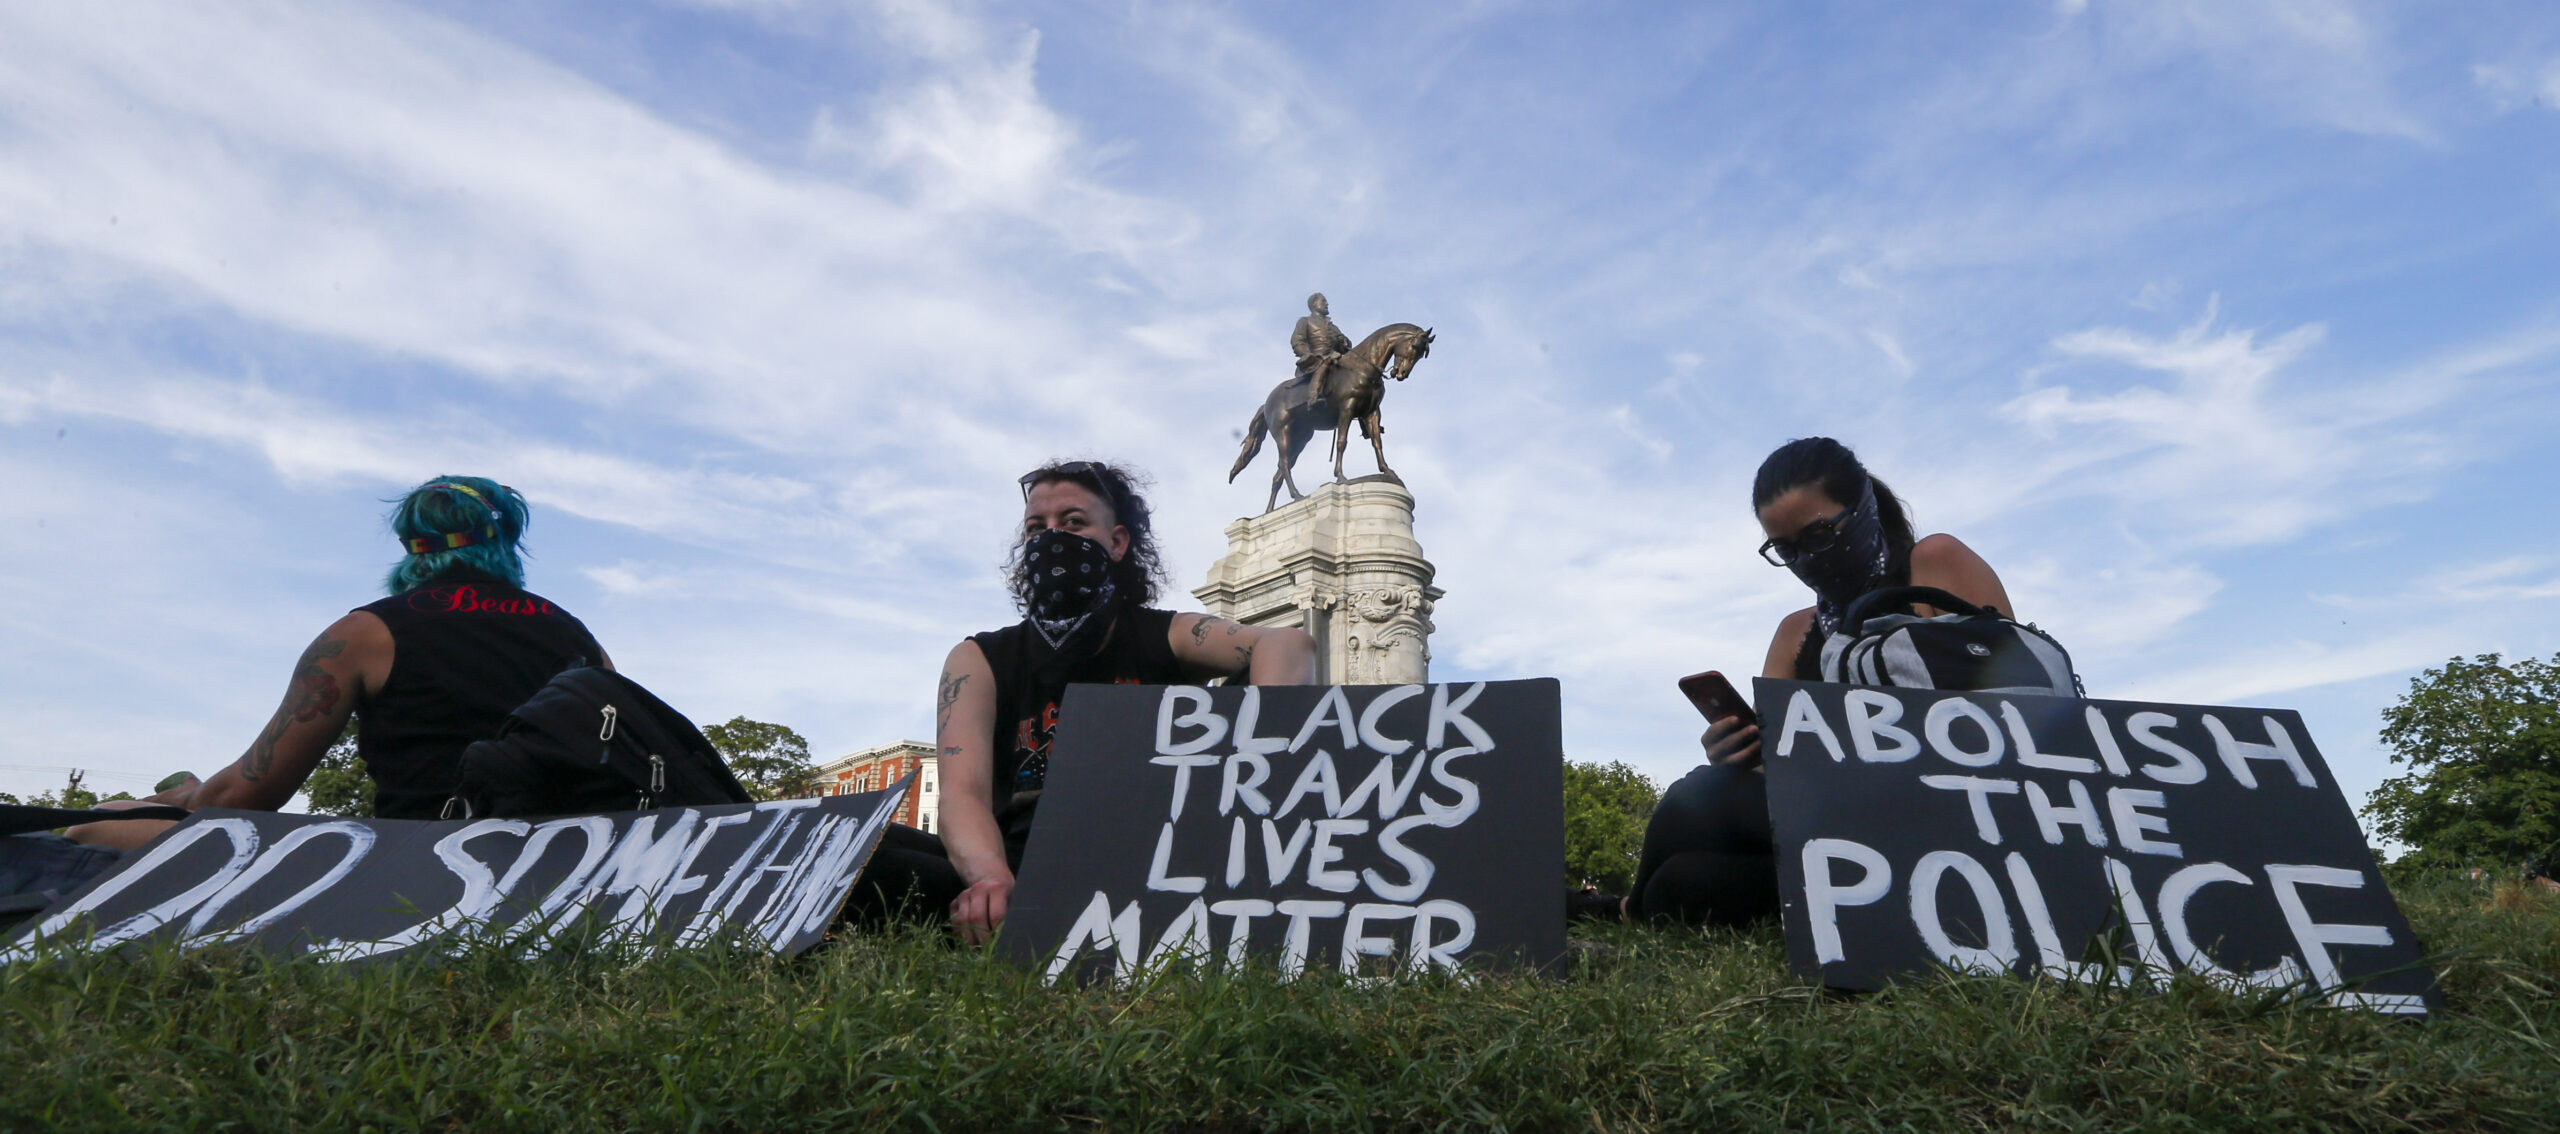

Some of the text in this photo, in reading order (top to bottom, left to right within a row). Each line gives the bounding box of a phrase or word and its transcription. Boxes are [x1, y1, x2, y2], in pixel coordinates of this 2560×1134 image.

[1155, 682, 1495, 755] BLACK
[1776, 689, 2318, 789] ABOLISH
[1149, 746, 1480, 827] TRANS
[1919, 774, 2183, 858] THE
[0, 817, 377, 963] DO
[1147, 814, 1435, 901] LIVES
[1042, 890, 1480, 989] MATTER
[1801, 838, 2428, 1015] POLICE
